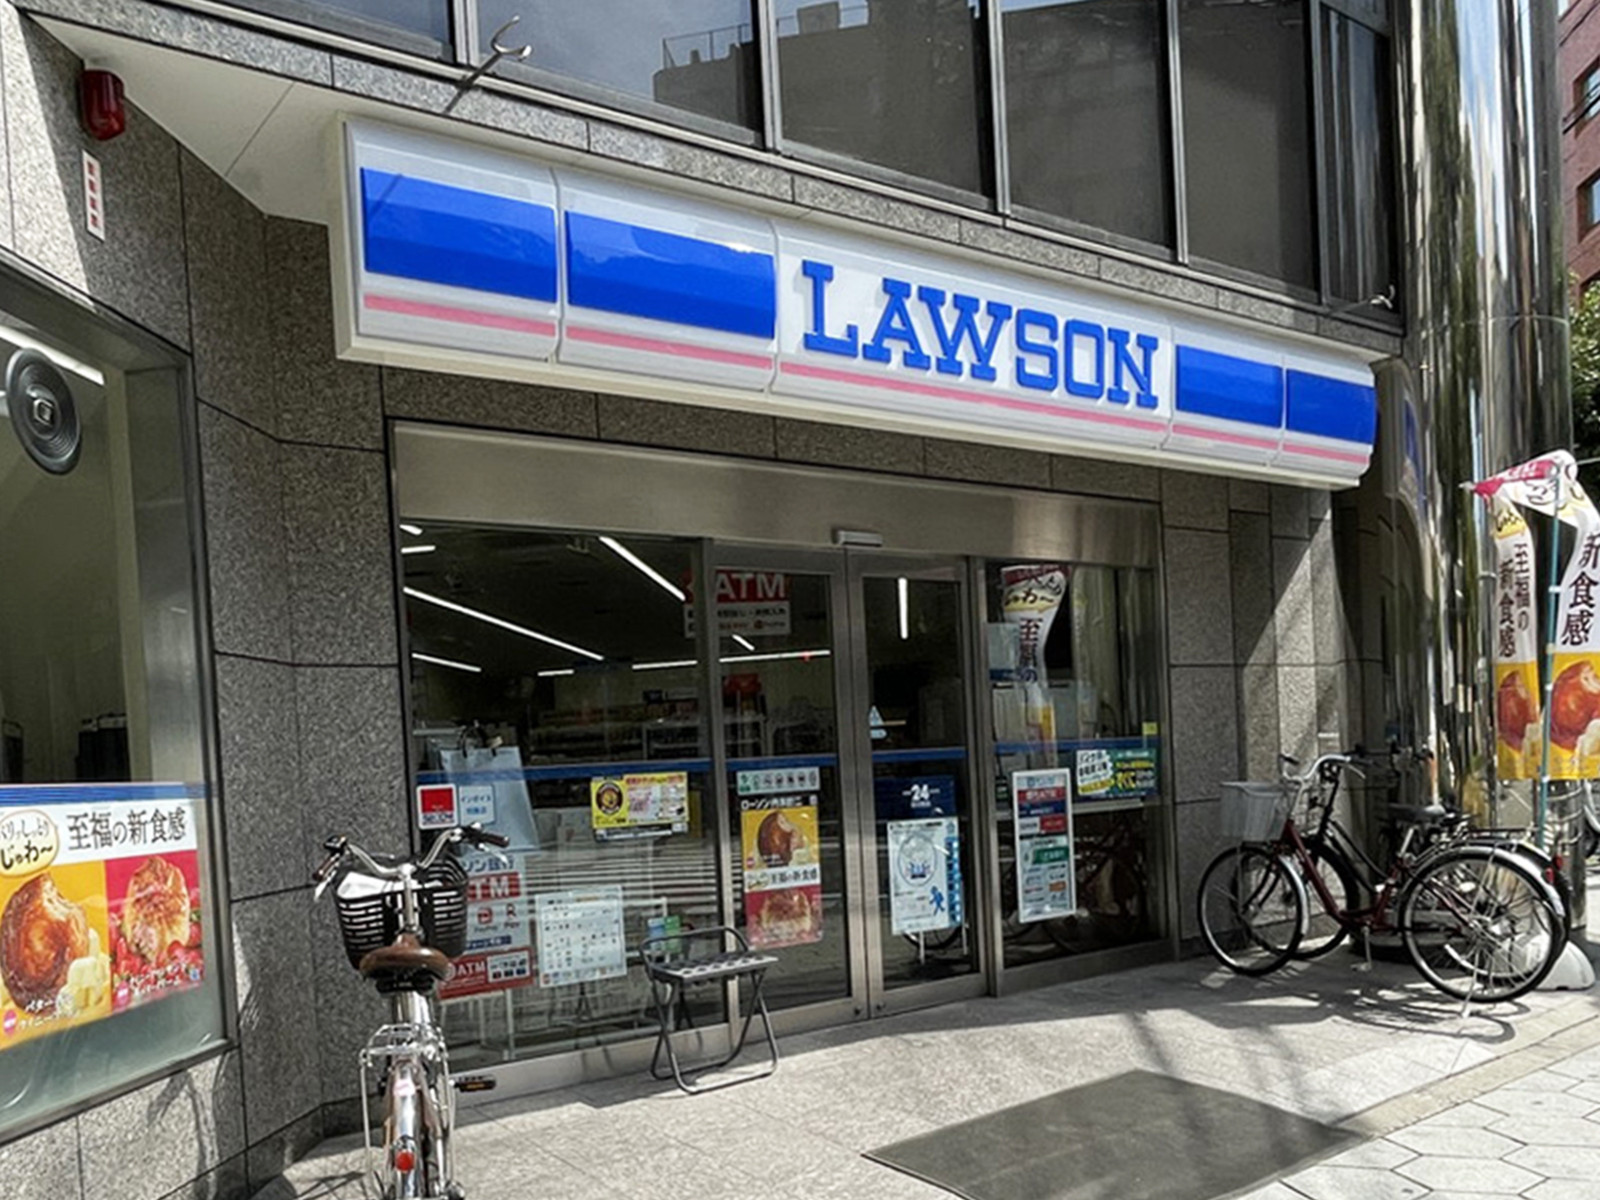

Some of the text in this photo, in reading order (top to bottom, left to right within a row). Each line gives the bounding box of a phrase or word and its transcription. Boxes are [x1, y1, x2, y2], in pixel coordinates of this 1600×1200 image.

[802, 259, 1158, 408] LAWSON
[715, 572, 785, 599] ATM
[1499, 559, 1516, 658] 新食感
[910, 784, 930, 801] 24
[66, 806, 187, 850] 至福の新食感
[462, 858, 514, 872] ソン銀行
[466, 875, 512, 898] TM
[457, 961, 486, 976] ATM
